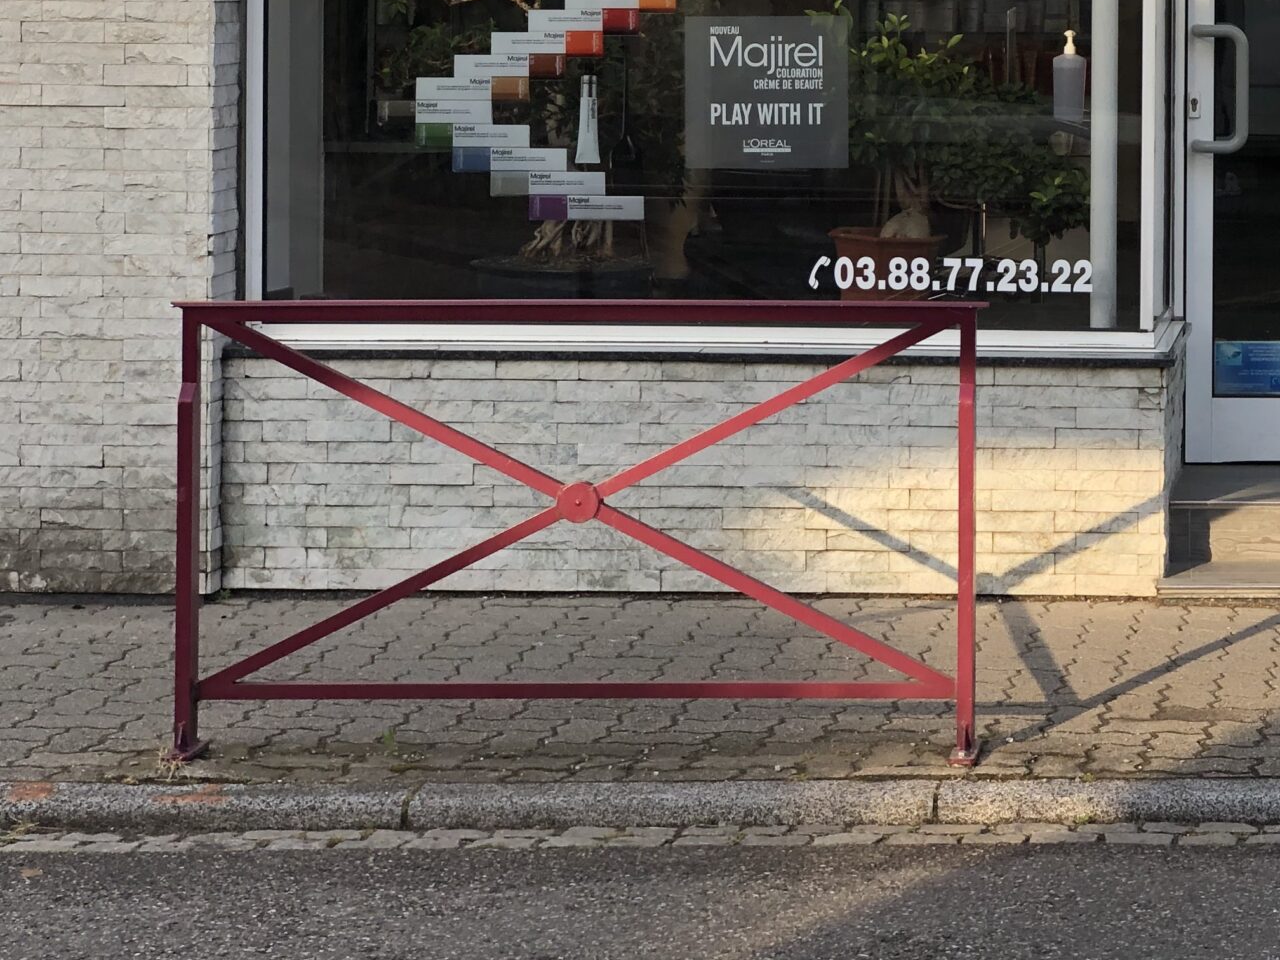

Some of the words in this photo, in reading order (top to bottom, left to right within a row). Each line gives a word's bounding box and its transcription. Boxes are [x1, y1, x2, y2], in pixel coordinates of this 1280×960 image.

[710, 26, 739, 35] NOUVEAU
[710, 35, 823, 75] Majirel
[776, 68, 823, 79] COLORATION
[753, 78, 780, 90] CRÈME
[782, 79, 792, 90] DE
[795, 78, 823, 90] BEAUTÉ
[710, 103, 752, 125] PLAY
[757, 103, 800, 125] WITH
[808, 103, 824, 125] IT
[743, 138, 792, 148] L'ORÉAL
[833, 256, 1093, 293] 03.88.77.23.22
